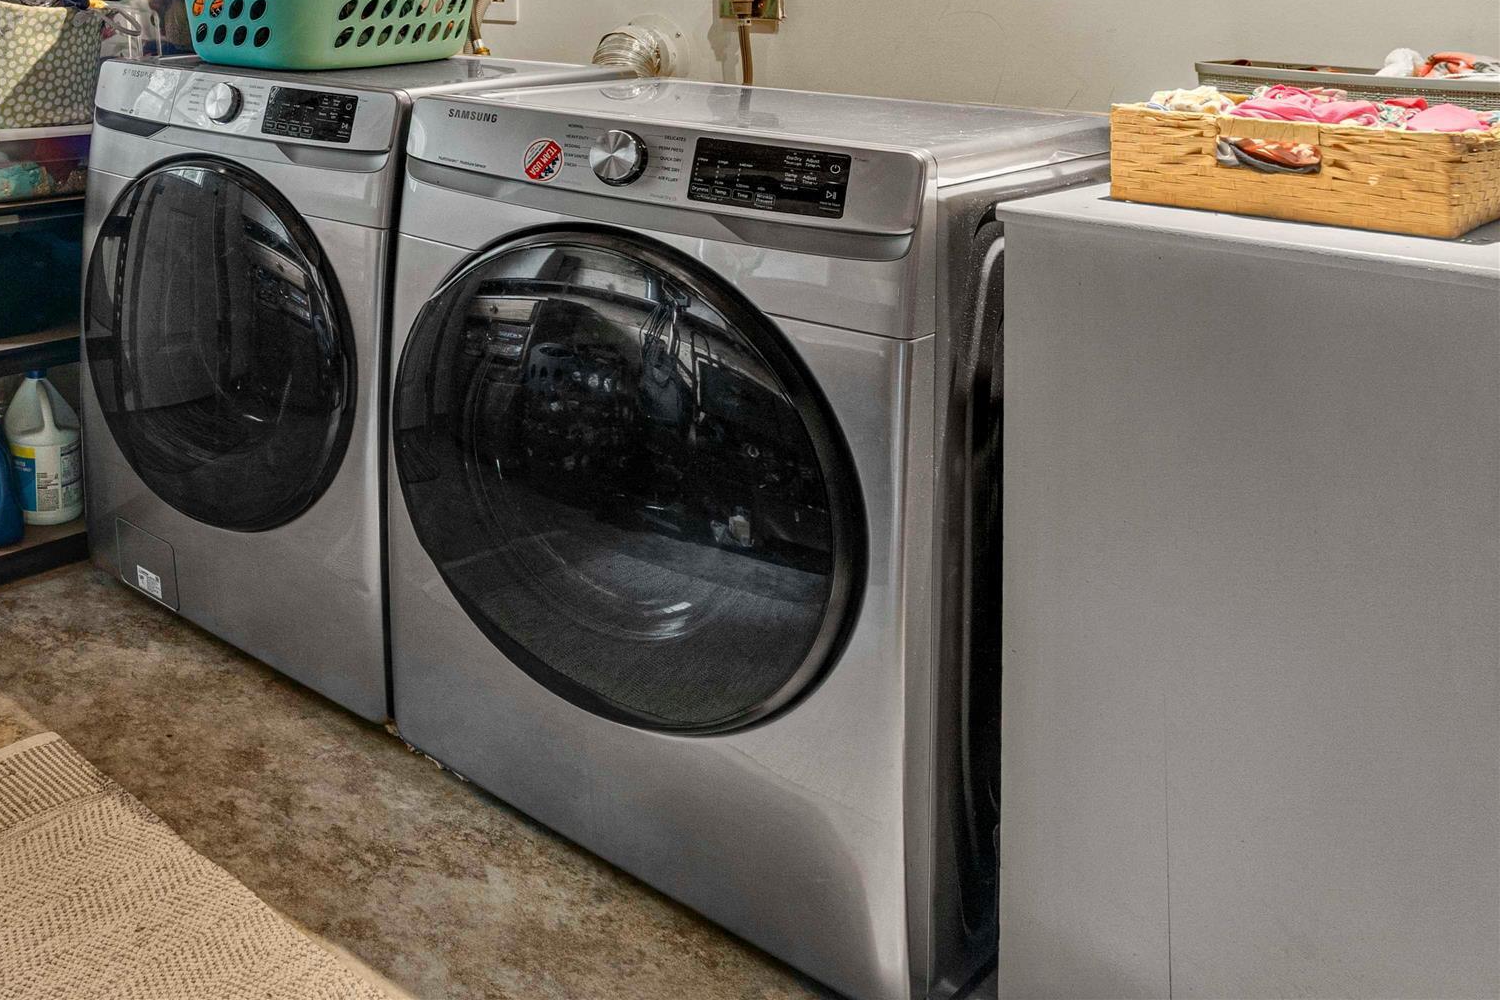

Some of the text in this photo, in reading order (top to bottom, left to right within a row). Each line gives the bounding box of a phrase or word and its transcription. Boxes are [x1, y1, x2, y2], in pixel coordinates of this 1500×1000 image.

[448, 108, 498, 123] SAMSUNG
[542, 145, 558, 165] TEAM
[530, 161, 543, 176] USA
